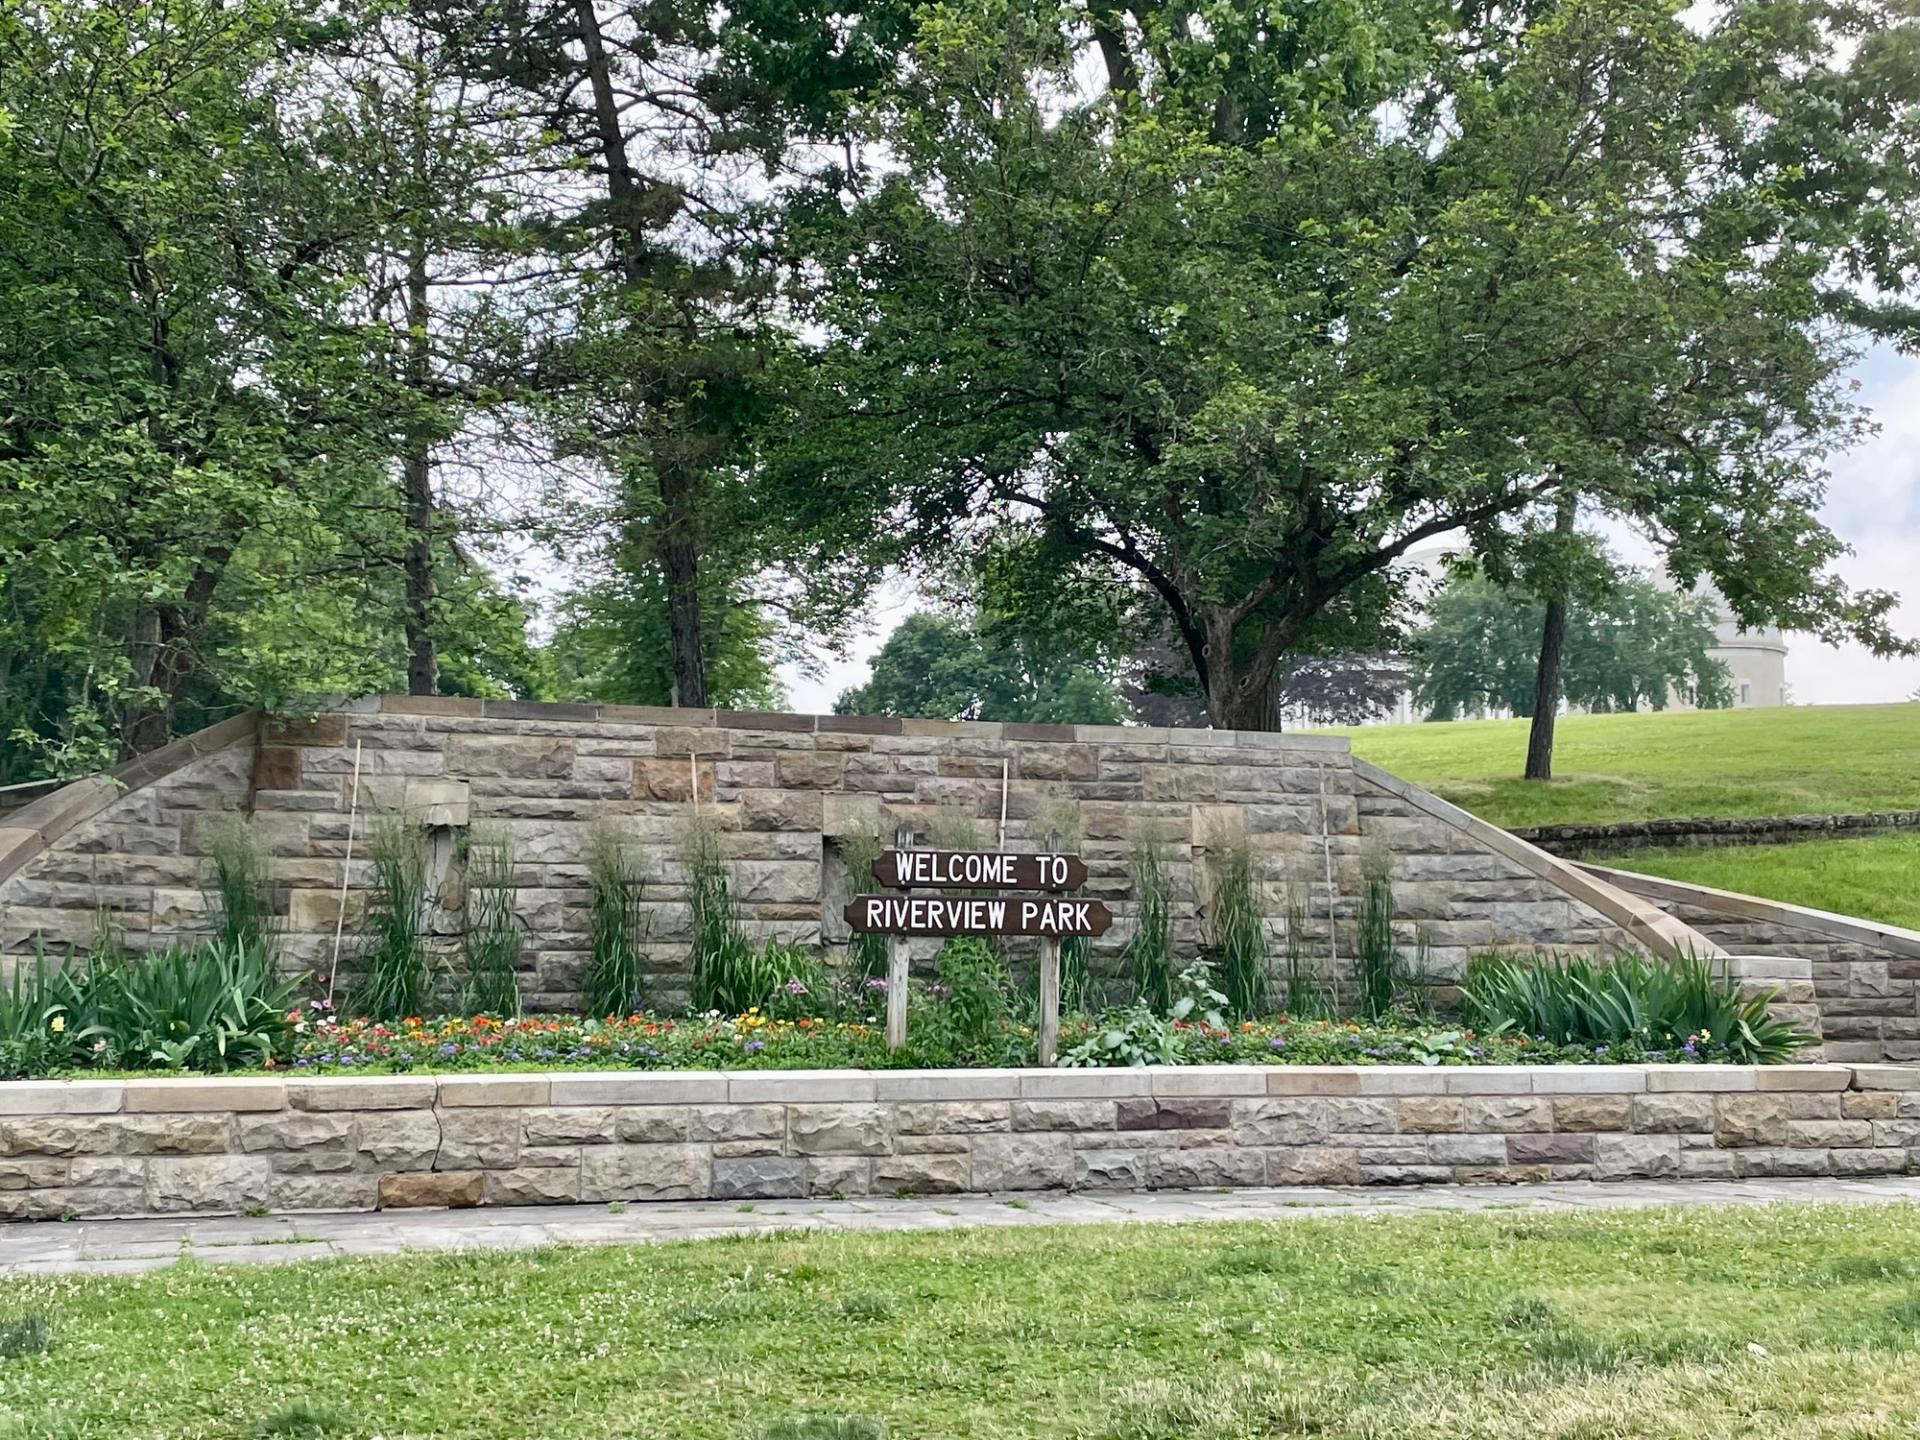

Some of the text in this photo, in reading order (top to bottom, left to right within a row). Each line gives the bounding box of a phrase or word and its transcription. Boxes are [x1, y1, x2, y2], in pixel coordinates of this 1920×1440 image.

[896, 852, 1068, 884] WELCOME TO
[867, 899, 1092, 931] RIVERVIEW PARK
